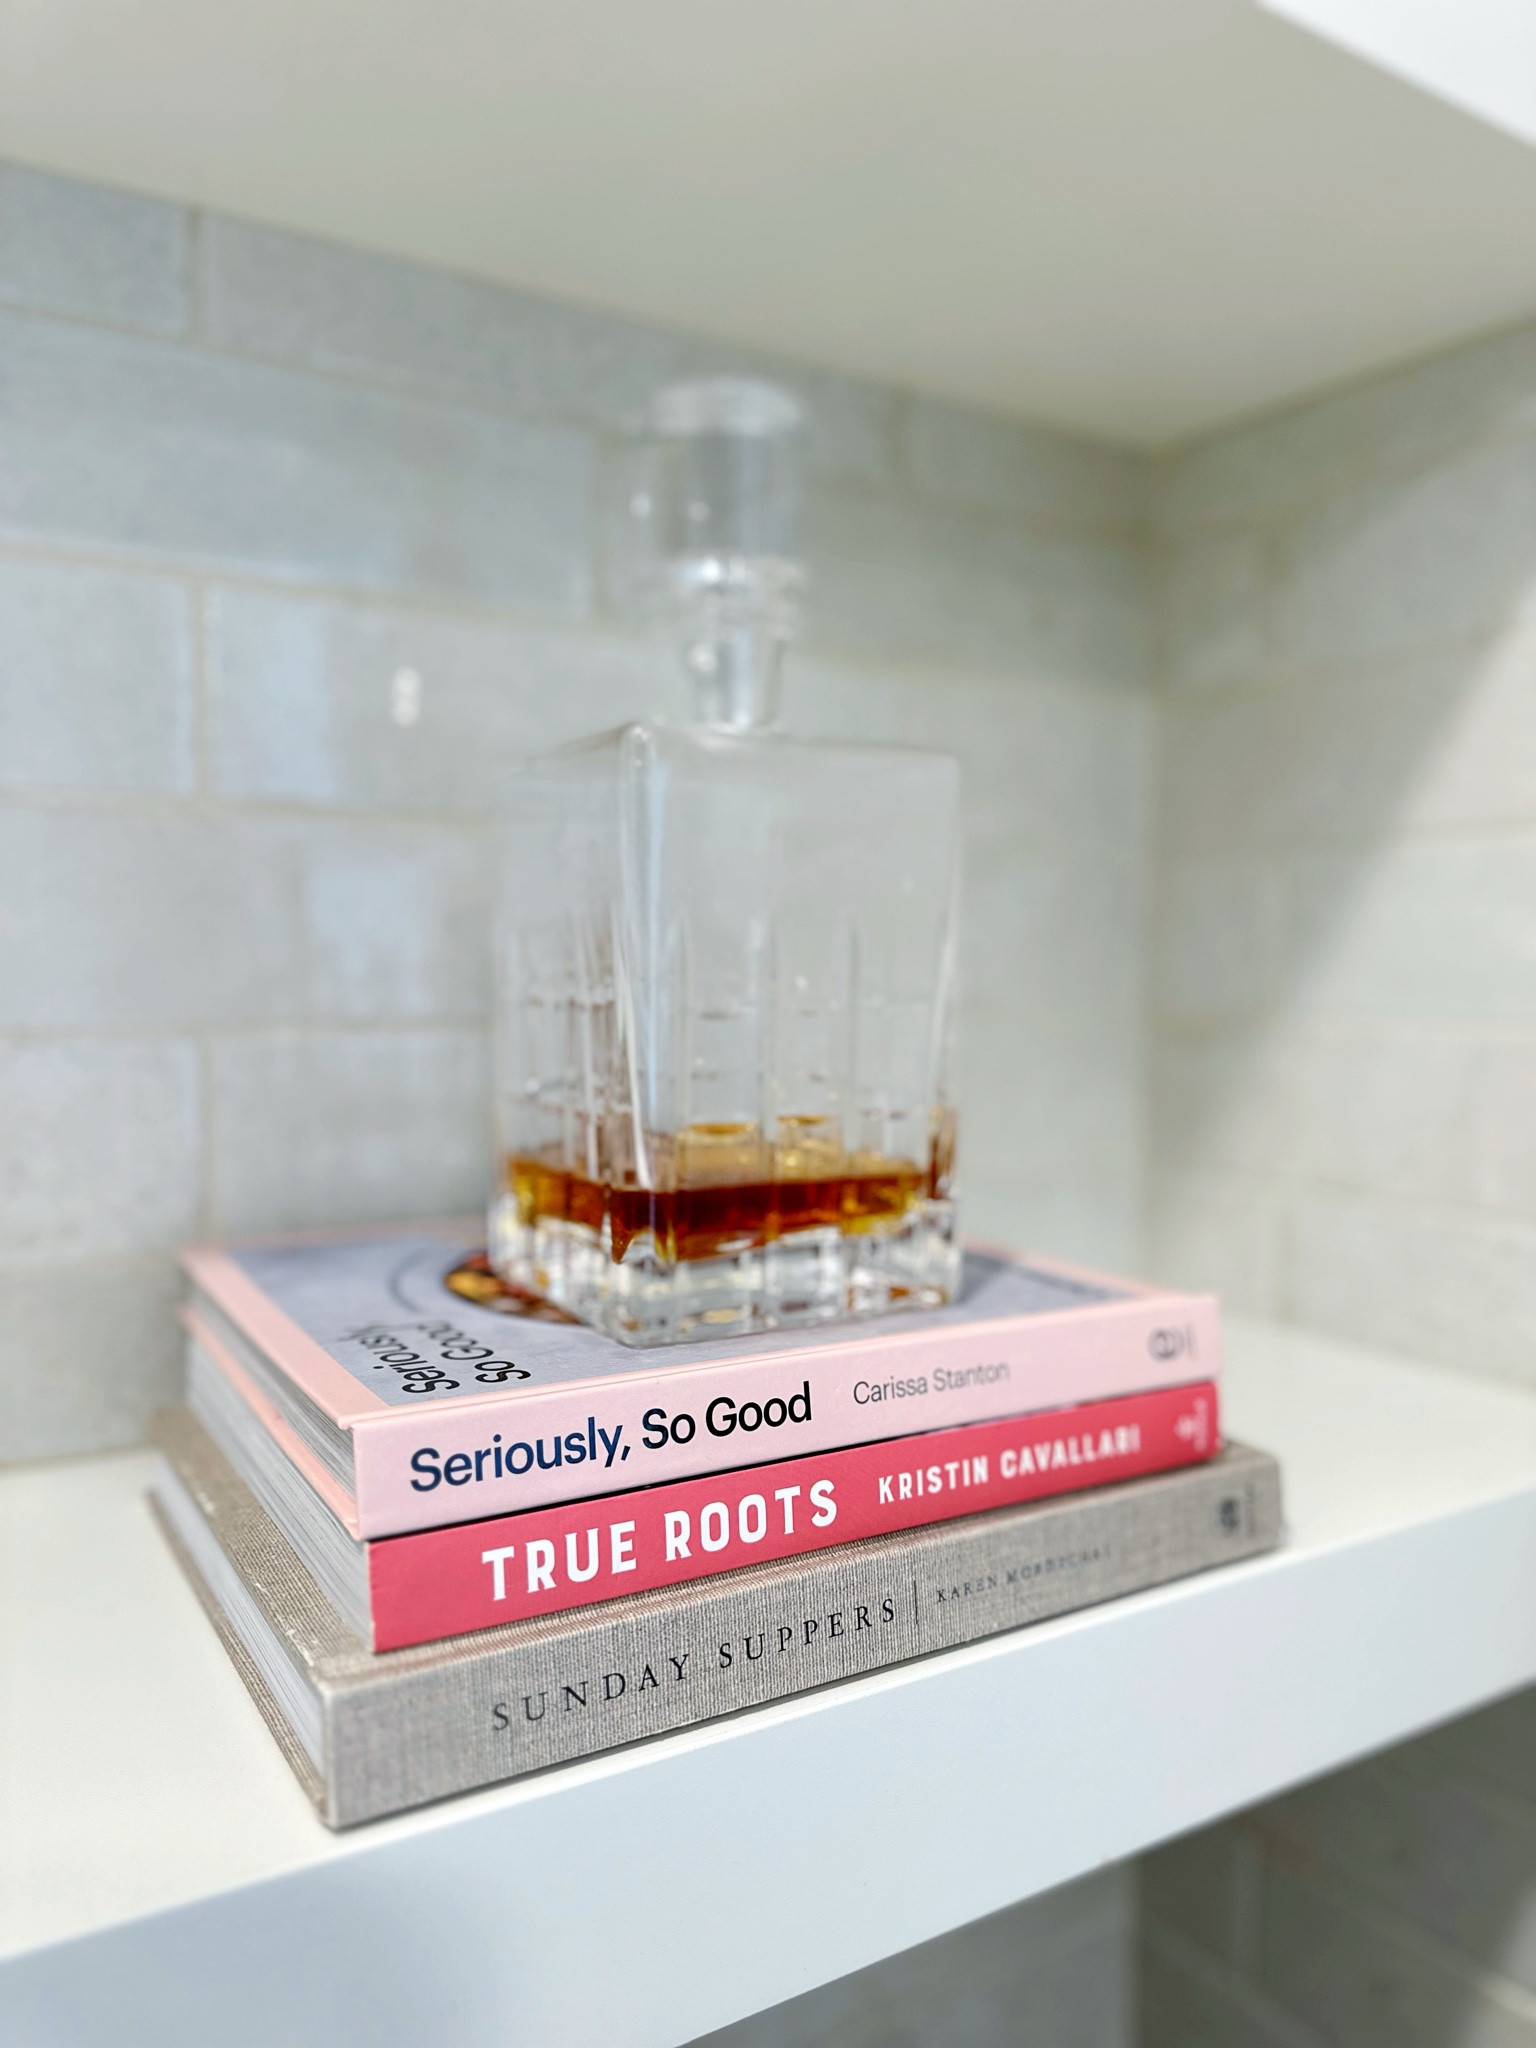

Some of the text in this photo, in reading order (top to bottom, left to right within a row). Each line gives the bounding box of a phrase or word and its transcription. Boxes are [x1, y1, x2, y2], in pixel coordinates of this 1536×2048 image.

[410, 1361, 1011, 1492] Seriously, So Good Carissa Stanton
[475, 1360, 531, 1383] So
[482, 1520, 637, 1601] TRUE
[664, 1479, 838, 1562] ROOTS
[878, 1455, 988, 1504] KRISTIN
[1001, 1423, 1141, 1478] CAVALLARI
[492, 1654, 690, 1731] SUNDAY
[719, 1599, 895, 1668] SUPPERS
[937, 1575, 998, 1602] KAREN
